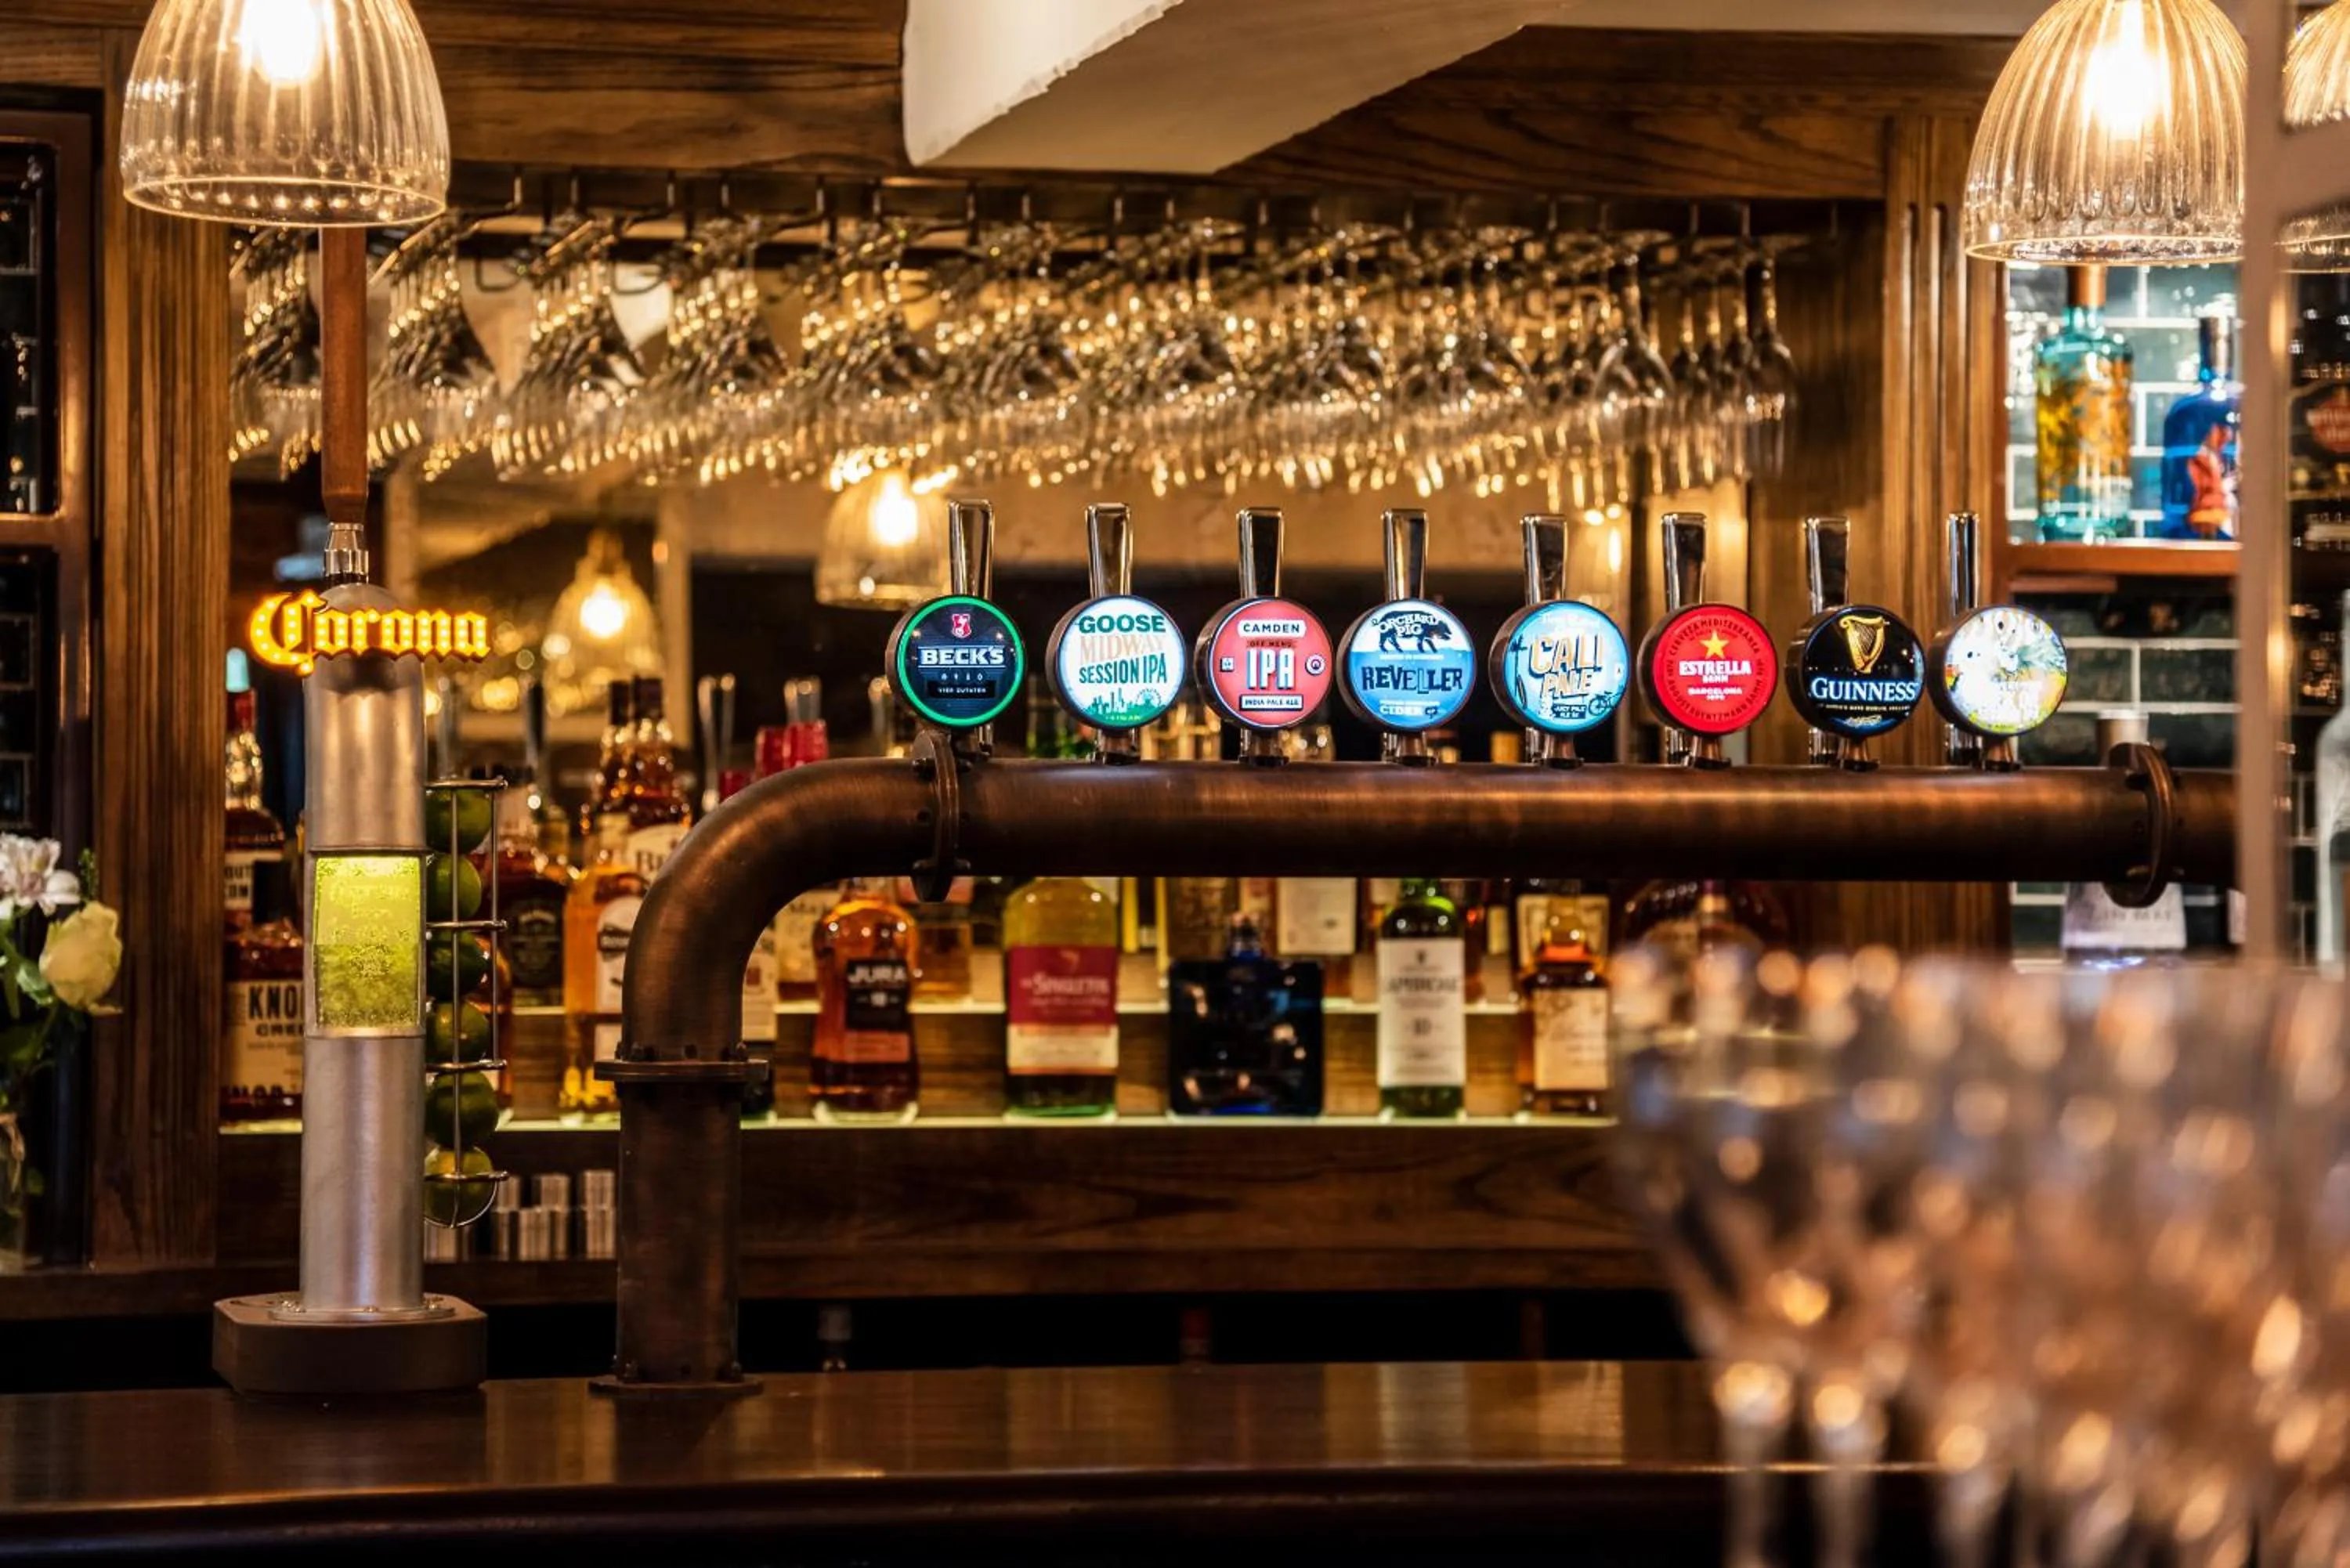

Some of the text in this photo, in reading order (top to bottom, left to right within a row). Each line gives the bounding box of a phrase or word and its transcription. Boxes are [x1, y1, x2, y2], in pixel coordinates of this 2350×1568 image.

[249, 589, 491, 676] Corona
[1078, 614, 1166, 633] GOOSE
[1243, 623, 1300, 634] CAMDEN
[1379, 613, 1441, 633] ORCHARD
[1397, 623, 1423, 637] PIG
[920, 645, 1004, 665] BECK'S
[1080, 634, 1166, 664] MIDWAY
[1528, 634, 1603, 678] CALI
[1079, 652, 1167, 684] SESSION IPA
[1247, 649, 1295, 689] IPA
[1361, 666, 1462, 694] REVELLER
[1679, 661, 1752, 675] ESTRELLA
[1810, 677, 1918, 702] GUINNESS
[848, 965, 907, 983] JURA
[248, 985, 304, 1019] KNO
